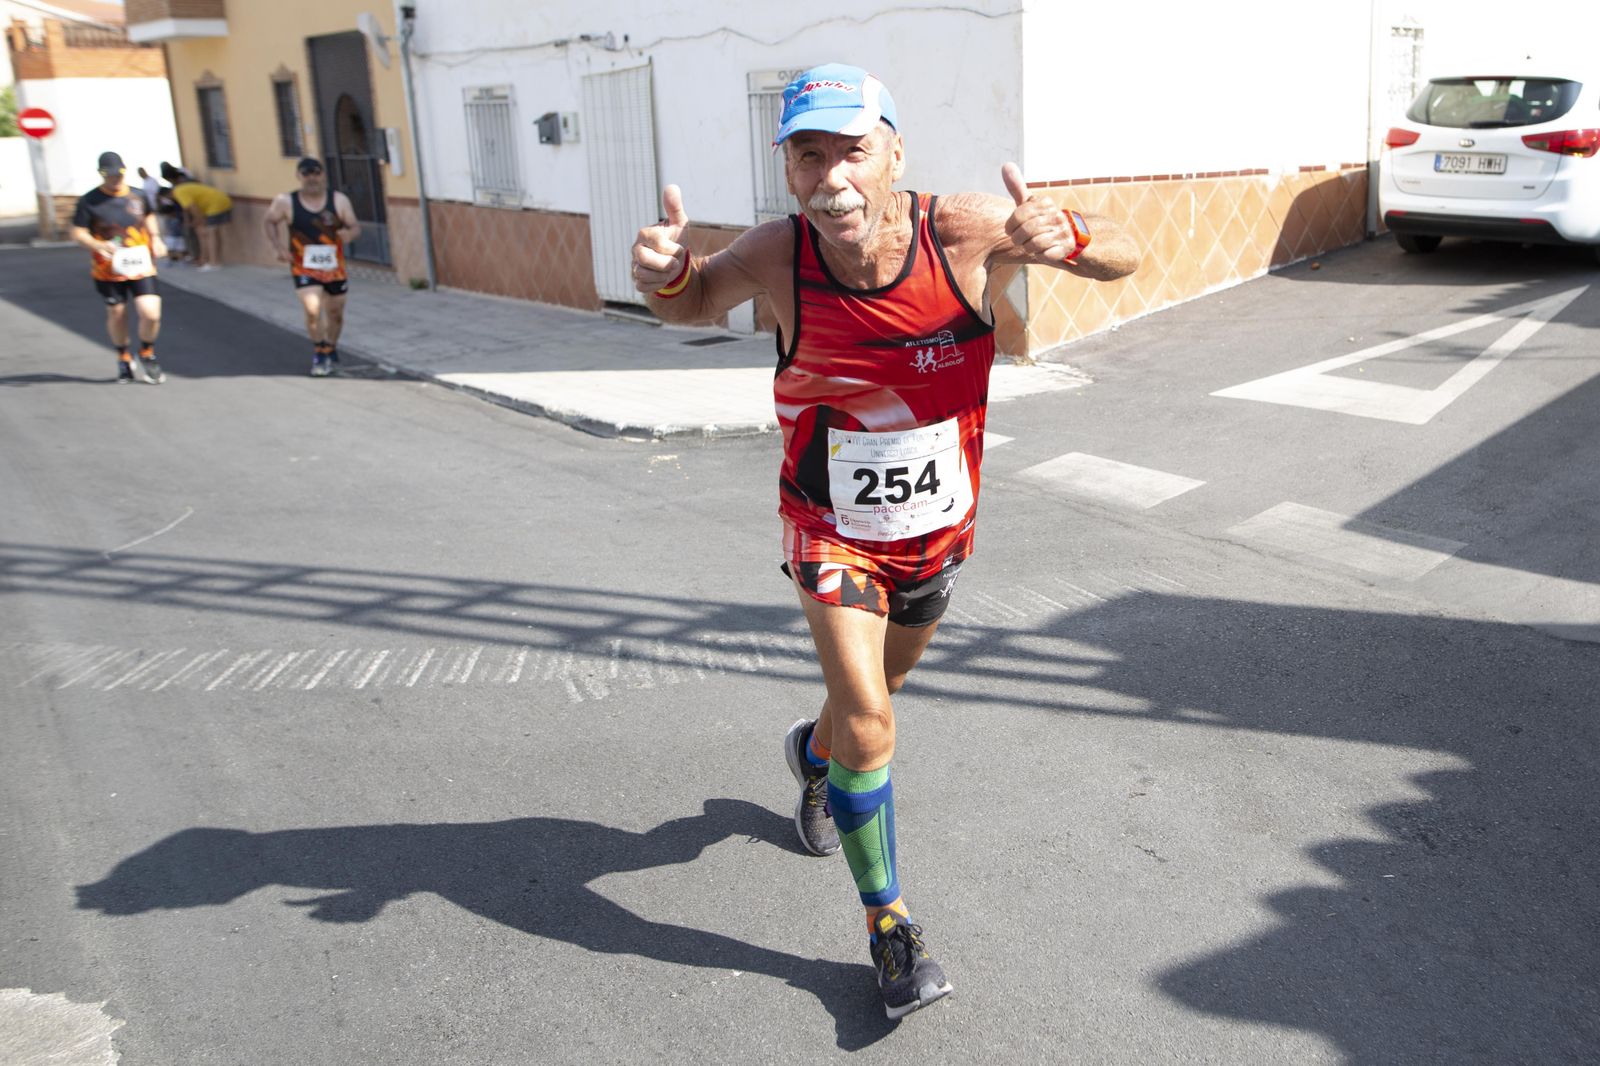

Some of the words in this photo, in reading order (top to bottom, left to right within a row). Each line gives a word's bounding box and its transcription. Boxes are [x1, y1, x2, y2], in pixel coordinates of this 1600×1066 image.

[1444, 155, 1471, 169] 7091
[1478, 158, 1502, 170] HWH
[905, 336, 939, 347] ATLETISMO
[853, 459, 940, 505] 254
[873, 499, 929, 515] pacoCam
